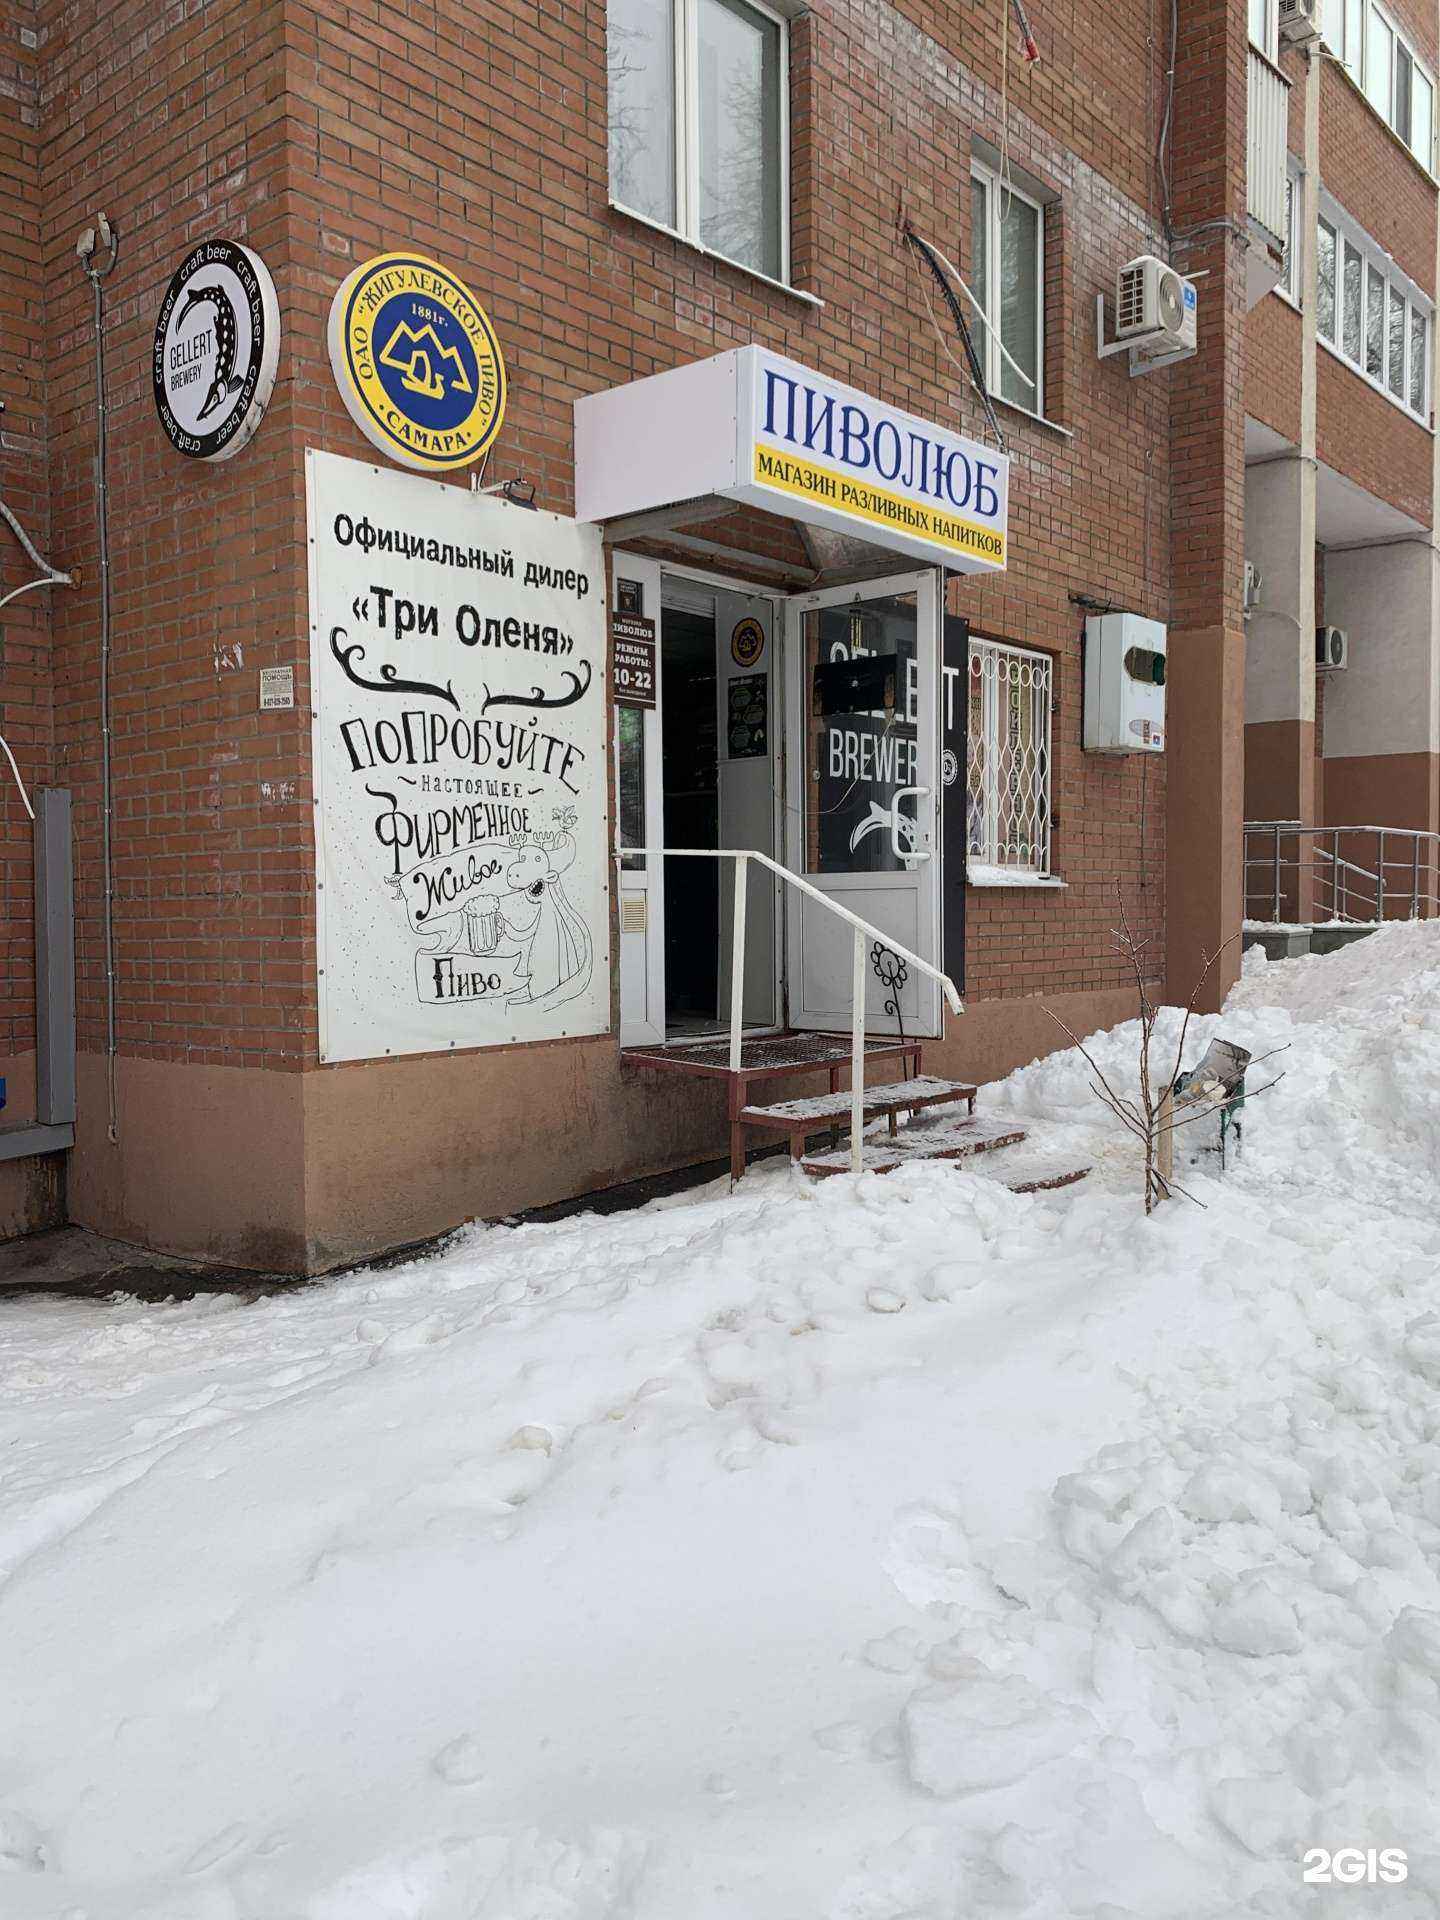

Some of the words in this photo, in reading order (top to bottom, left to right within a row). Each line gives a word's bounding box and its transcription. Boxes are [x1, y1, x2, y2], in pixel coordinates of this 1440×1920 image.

[180, 249, 205, 281] craft
[206, 245, 232, 263] beer
[236, 260, 258, 299] craft
[250, 297, 262, 347] beer
[410, 302, 450, 328] 1881г.
[154, 335, 164, 384] craft
[159, 289, 176, 333] beer
[169, 328, 212, 370] GELLERT
[353, 326, 374, 380] ОАО
[170, 363, 202, 391] BREWERY
[240, 365, 258, 411] craft
[160, 404, 178, 442] beer
[215, 415, 240, 446] beer
[386, 410, 468, 452] САМАРА
[763, 368, 999, 518] ПИВОЛЮБ
[758, 452, 836, 498] МАГАЗИН
[841, 483, 929, 531] РАЗЛИВНЫХ
[933, 519, 1002, 556] НАПИТКОВ
[333, 512, 515, 579] Официальный
[523, 563, 590, 599] дилер
[352, 585, 439, 641] «Три
[455, 604, 575, 656] Оленя»
[614, 653, 652, 667] РАБОТЫ:
[616, 642, 648, 656] РЕЖИМ
[613, 668, 652, 689] 10-22
[340, 709, 586, 796] ПОПРОБУЙТЕ
[829, 727, 918, 786] BREWER
[413, 854, 503, 921] Живое
